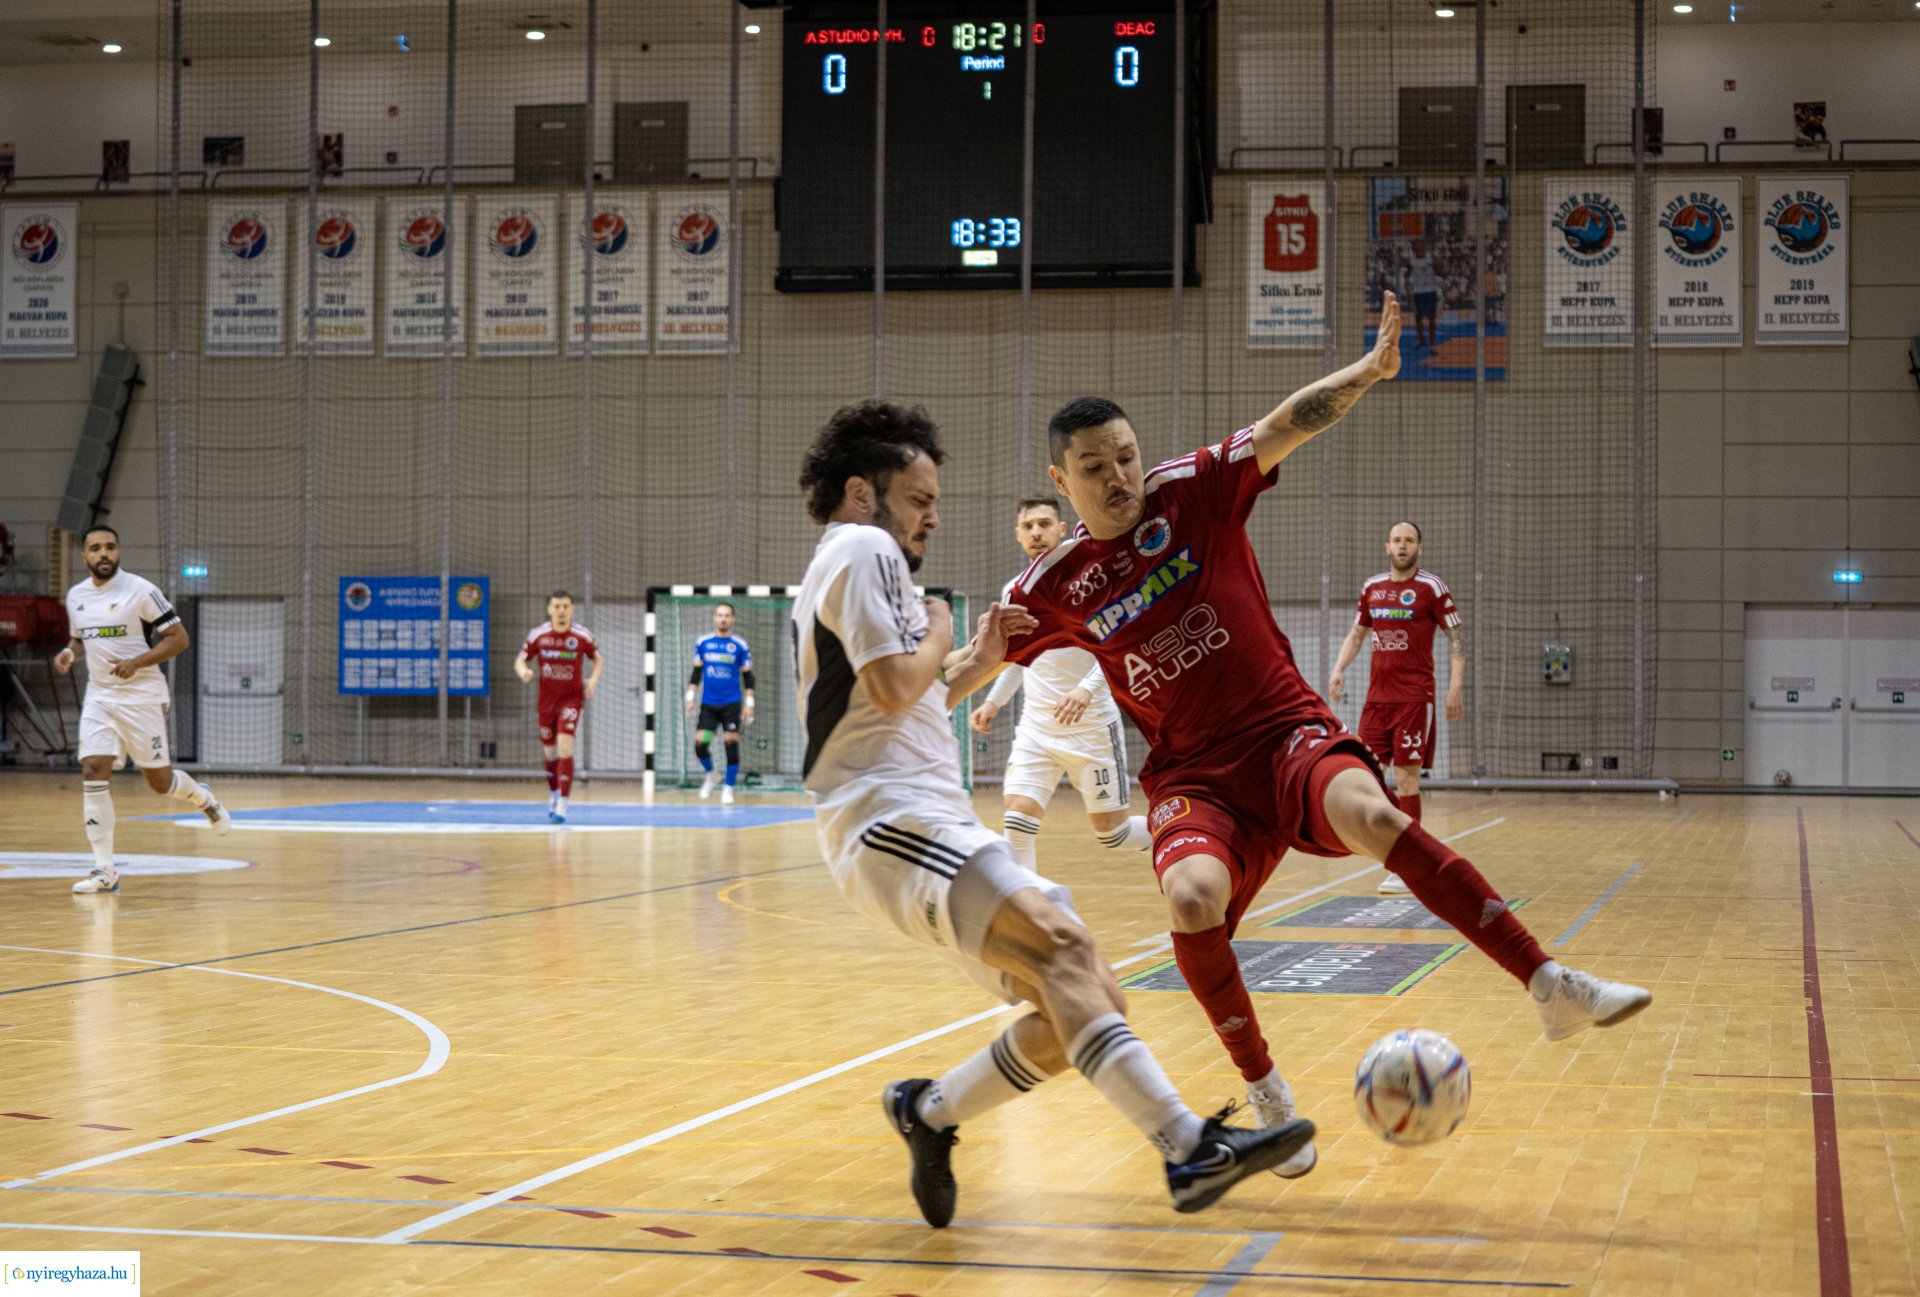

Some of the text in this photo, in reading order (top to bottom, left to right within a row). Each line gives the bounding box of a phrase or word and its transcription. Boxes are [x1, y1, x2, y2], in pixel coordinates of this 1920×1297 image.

[818, 28, 871, 45] STUDIO
[921, 26, 936, 47] 0
[952, 22, 1022, 51] 18:21
[1115, 21, 1156, 36] DEAC
[961, 55, 1005, 72] Period
[1115, 46, 1139, 86] 0
[823, 54, 846, 94] 0
[982, 80, 991, 100] 1
[1551, 191, 1628, 232] BLUE SHARKS
[1658, 191, 1734, 232] BLUE SHARKS
[1764, 190, 1841, 230] BLUE SHARKS
[951, 217, 1021, 248] 18:33
[1276, 223, 1306, 256] 15
[1260, 284, 1290, 297] Sitku
[1576, 281, 1601, 293] 2017
[1684, 281, 1709, 293] 2018
[1790, 279, 1815, 291] 2019
[1561, 297, 1616, 307] HEPP KUPA
[1668, 297, 1724, 307] HEPP KUPA
[1774, 294, 1830, 305] HEPP KUPA
[1567, 312, 1626, 327] HELYEZÉS
[1659, 311, 1734, 327] II. HELYEZÉS
[1764, 309, 1840, 325] II. HELYEZÉS
[1068, 563, 1107, 605] 383
[1129, 628, 1230, 703] STUDIO
[1094, 768, 1110, 787] 10
